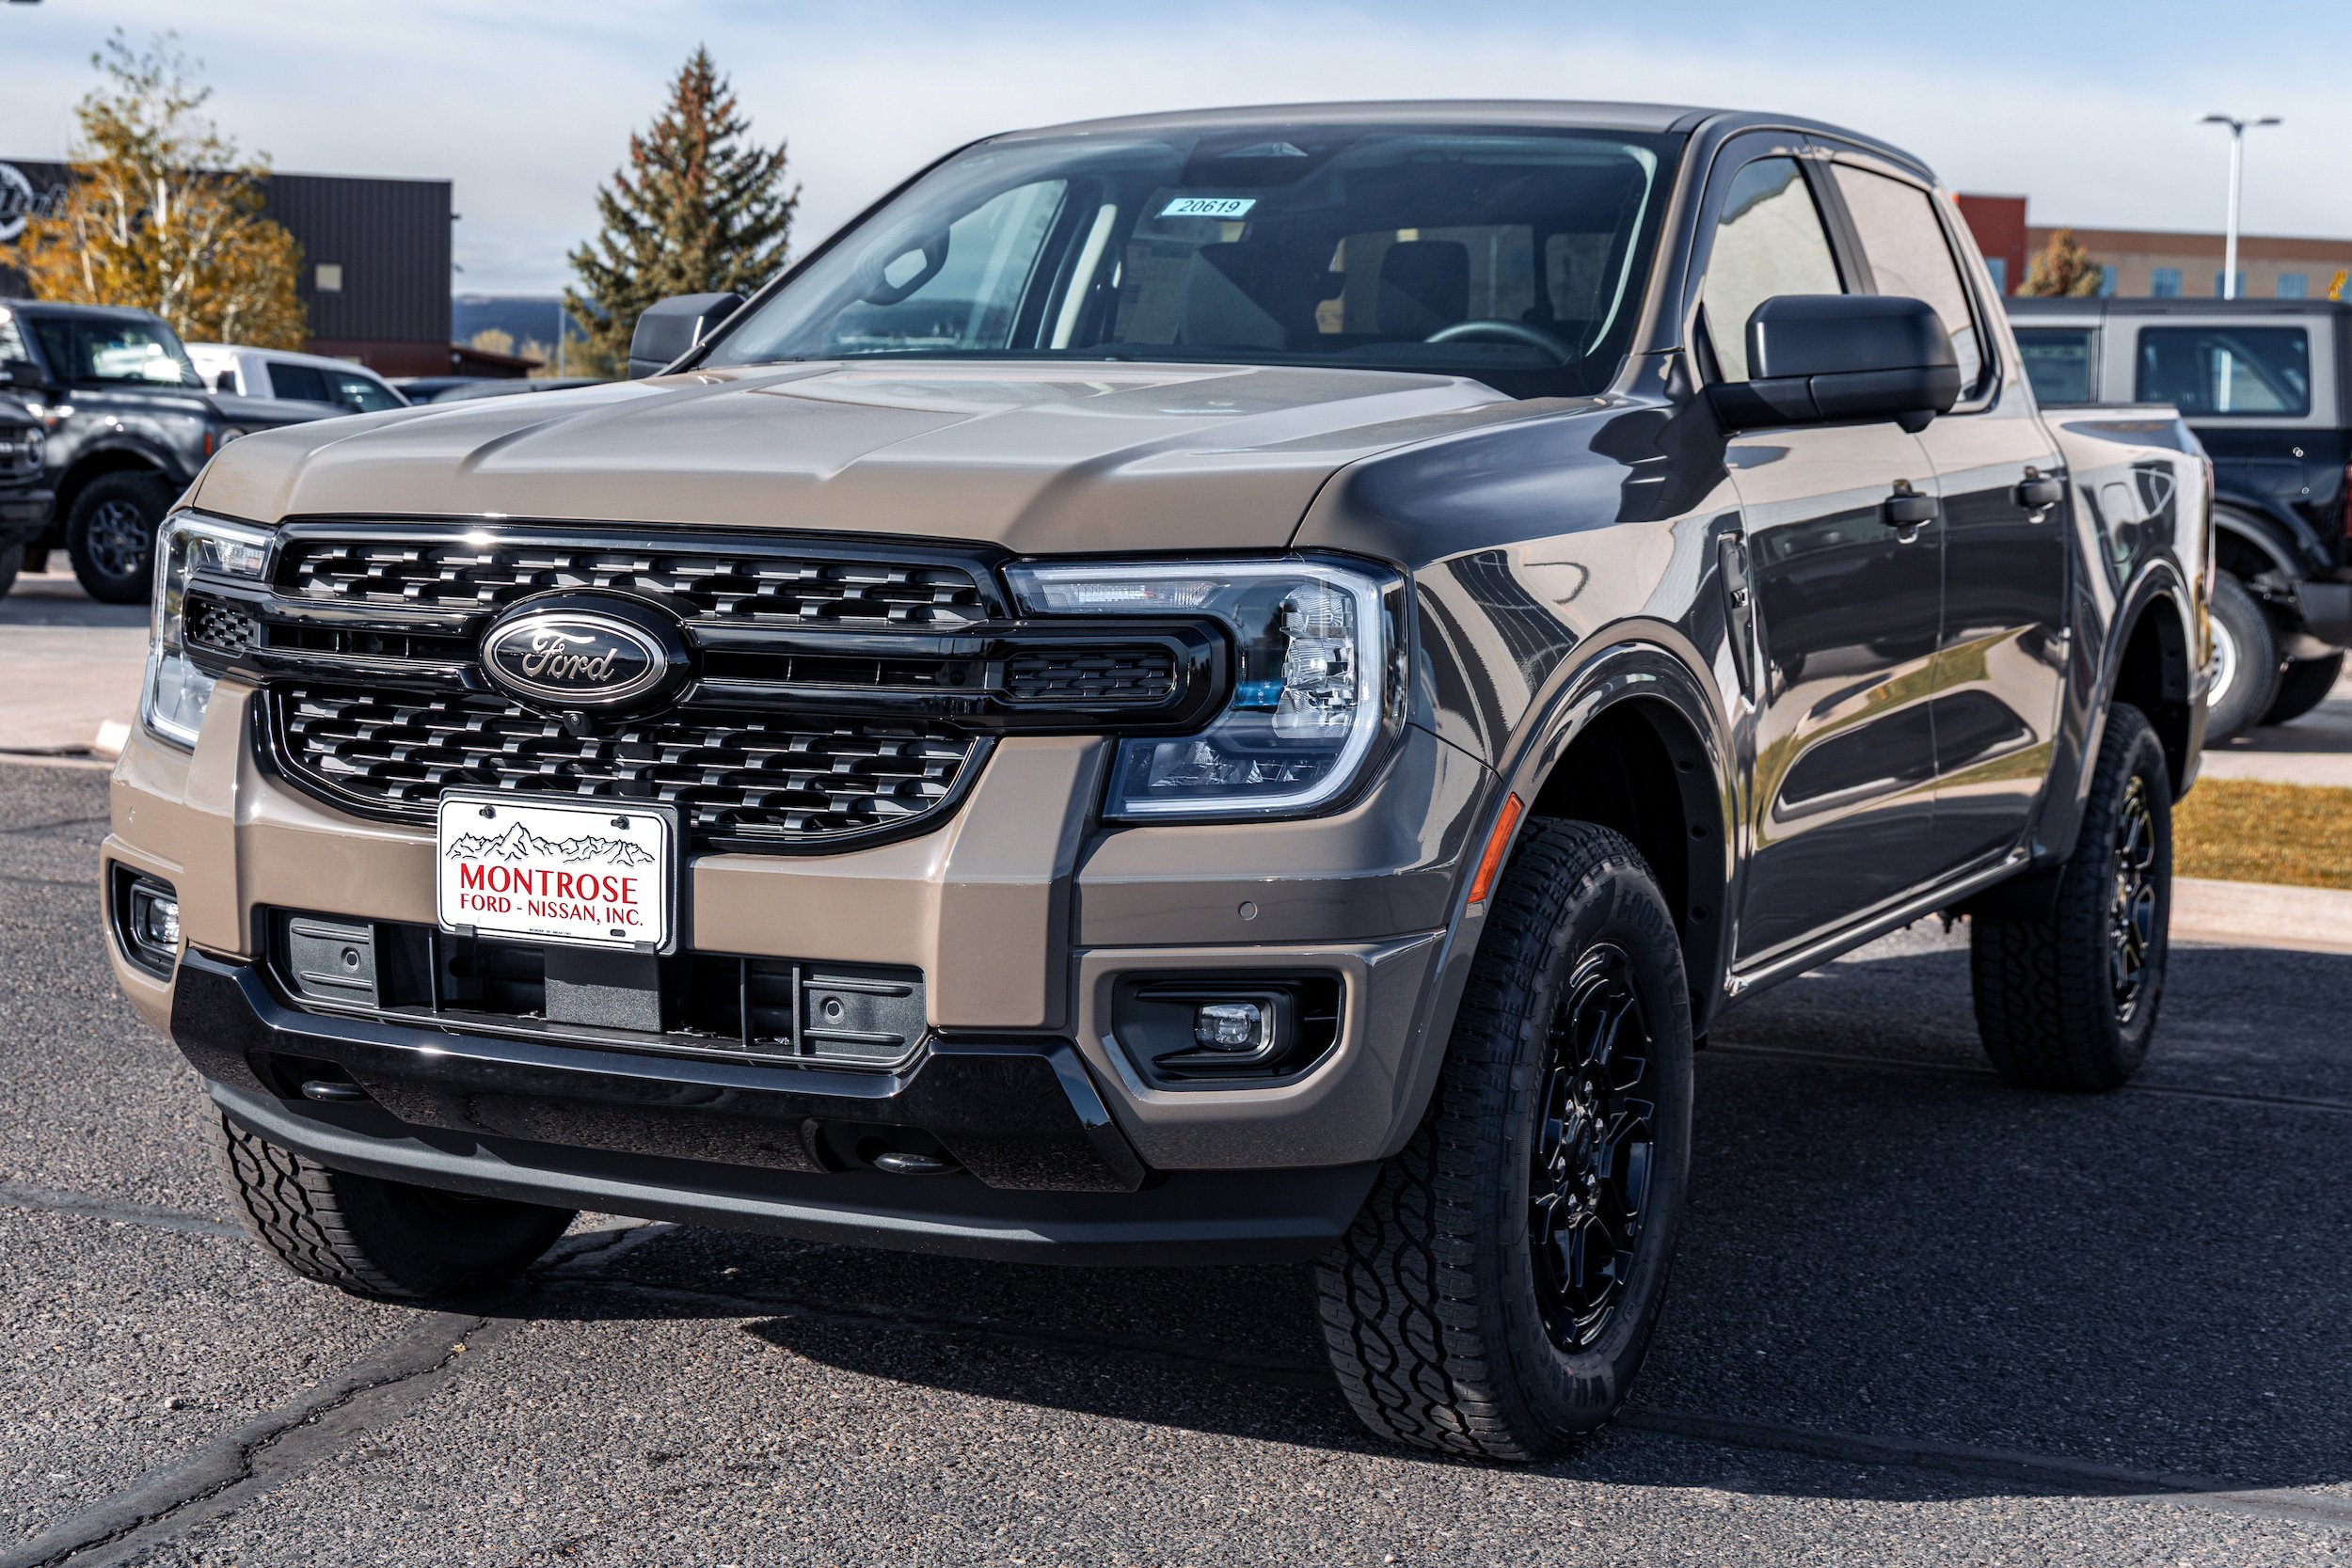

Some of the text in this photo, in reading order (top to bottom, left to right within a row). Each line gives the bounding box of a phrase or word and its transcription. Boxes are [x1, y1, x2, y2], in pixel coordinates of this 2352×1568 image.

[1178, 199, 1241, 213] 20619
[522, 627, 619, 681] Ford
[460, 863, 638, 904] MONTROSE
[460, 894, 511, 913] FORD
[528, 900, 601, 926] NISSAN,
[607, 907, 644, 927] INC.
